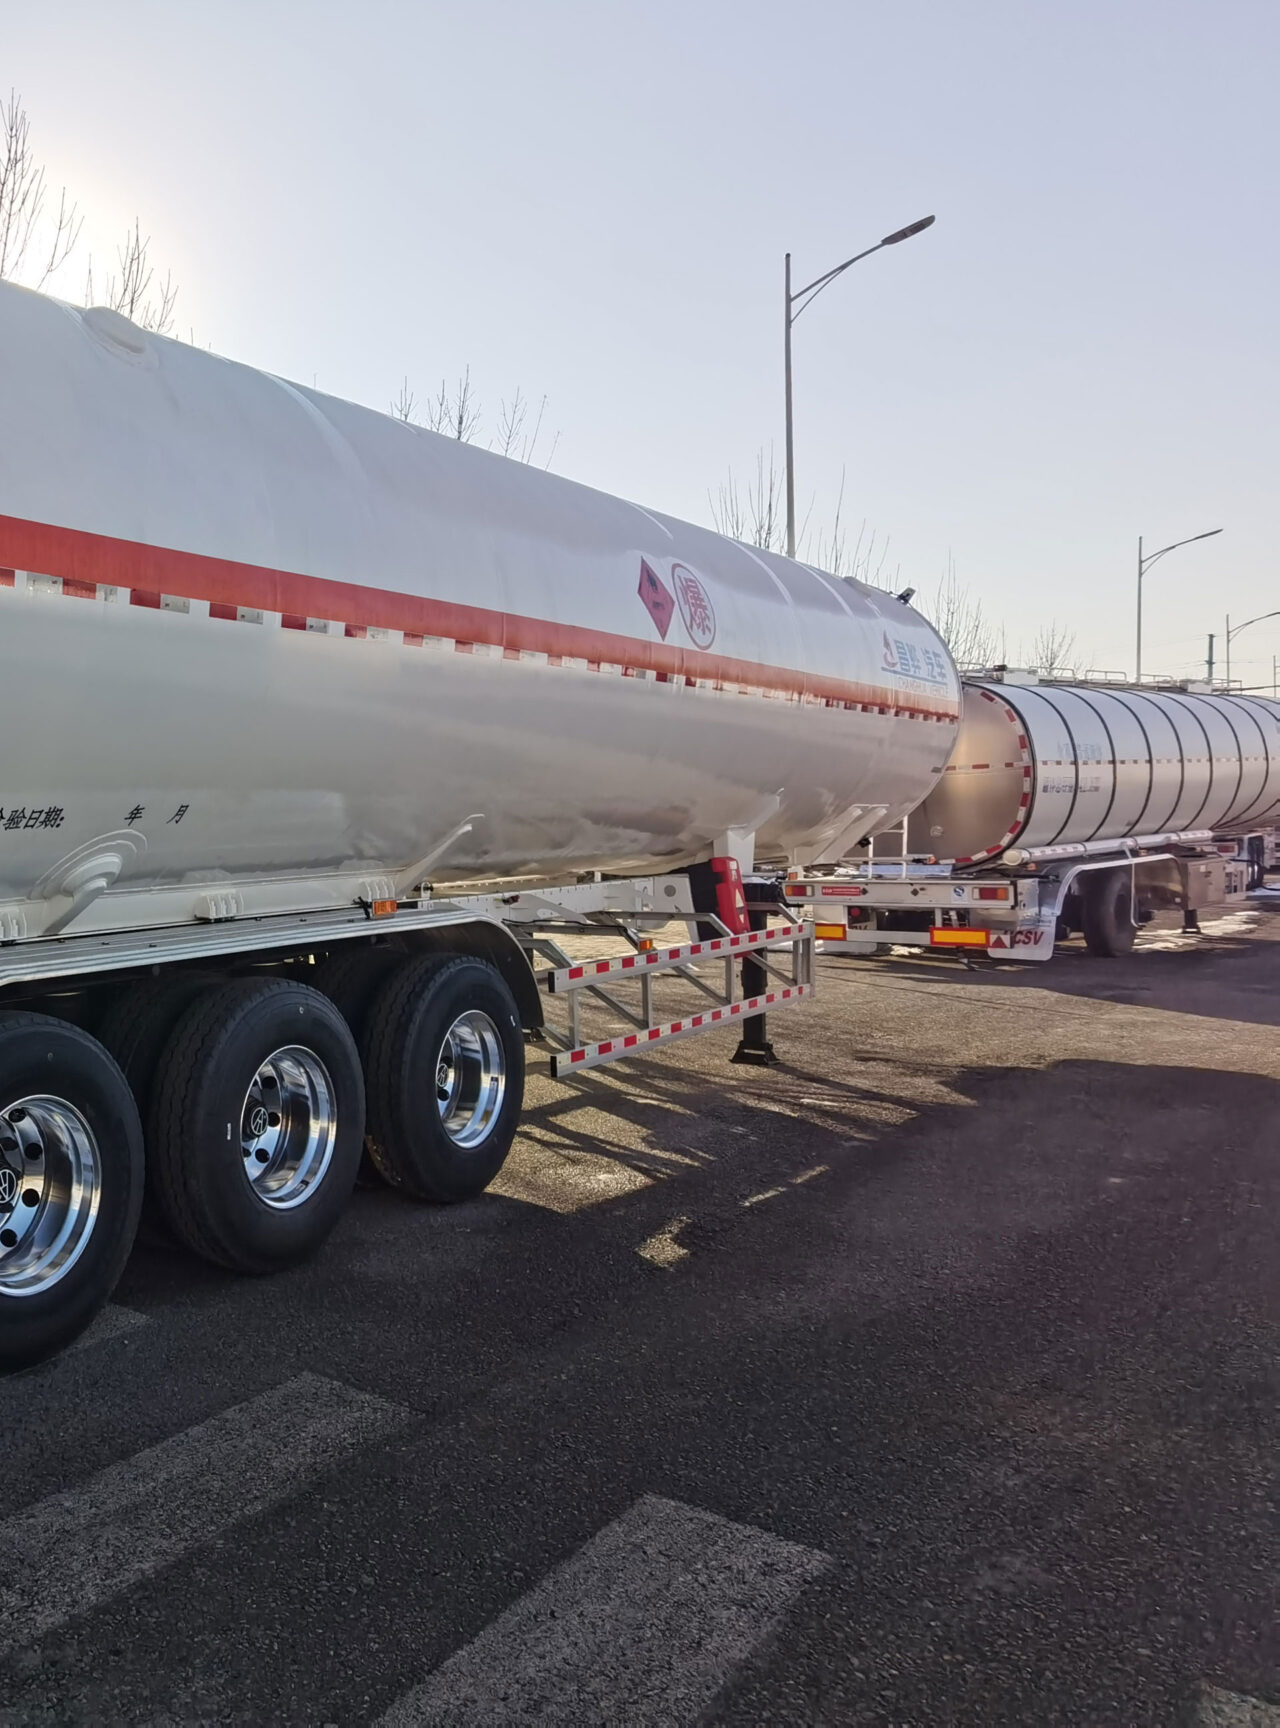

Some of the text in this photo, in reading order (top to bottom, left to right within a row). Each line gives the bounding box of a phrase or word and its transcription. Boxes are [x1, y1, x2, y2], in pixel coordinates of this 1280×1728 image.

[677, 574, 712, 636] 爆
[124, 804, 145, 826] 年
[167, 804, 190, 824] 月
